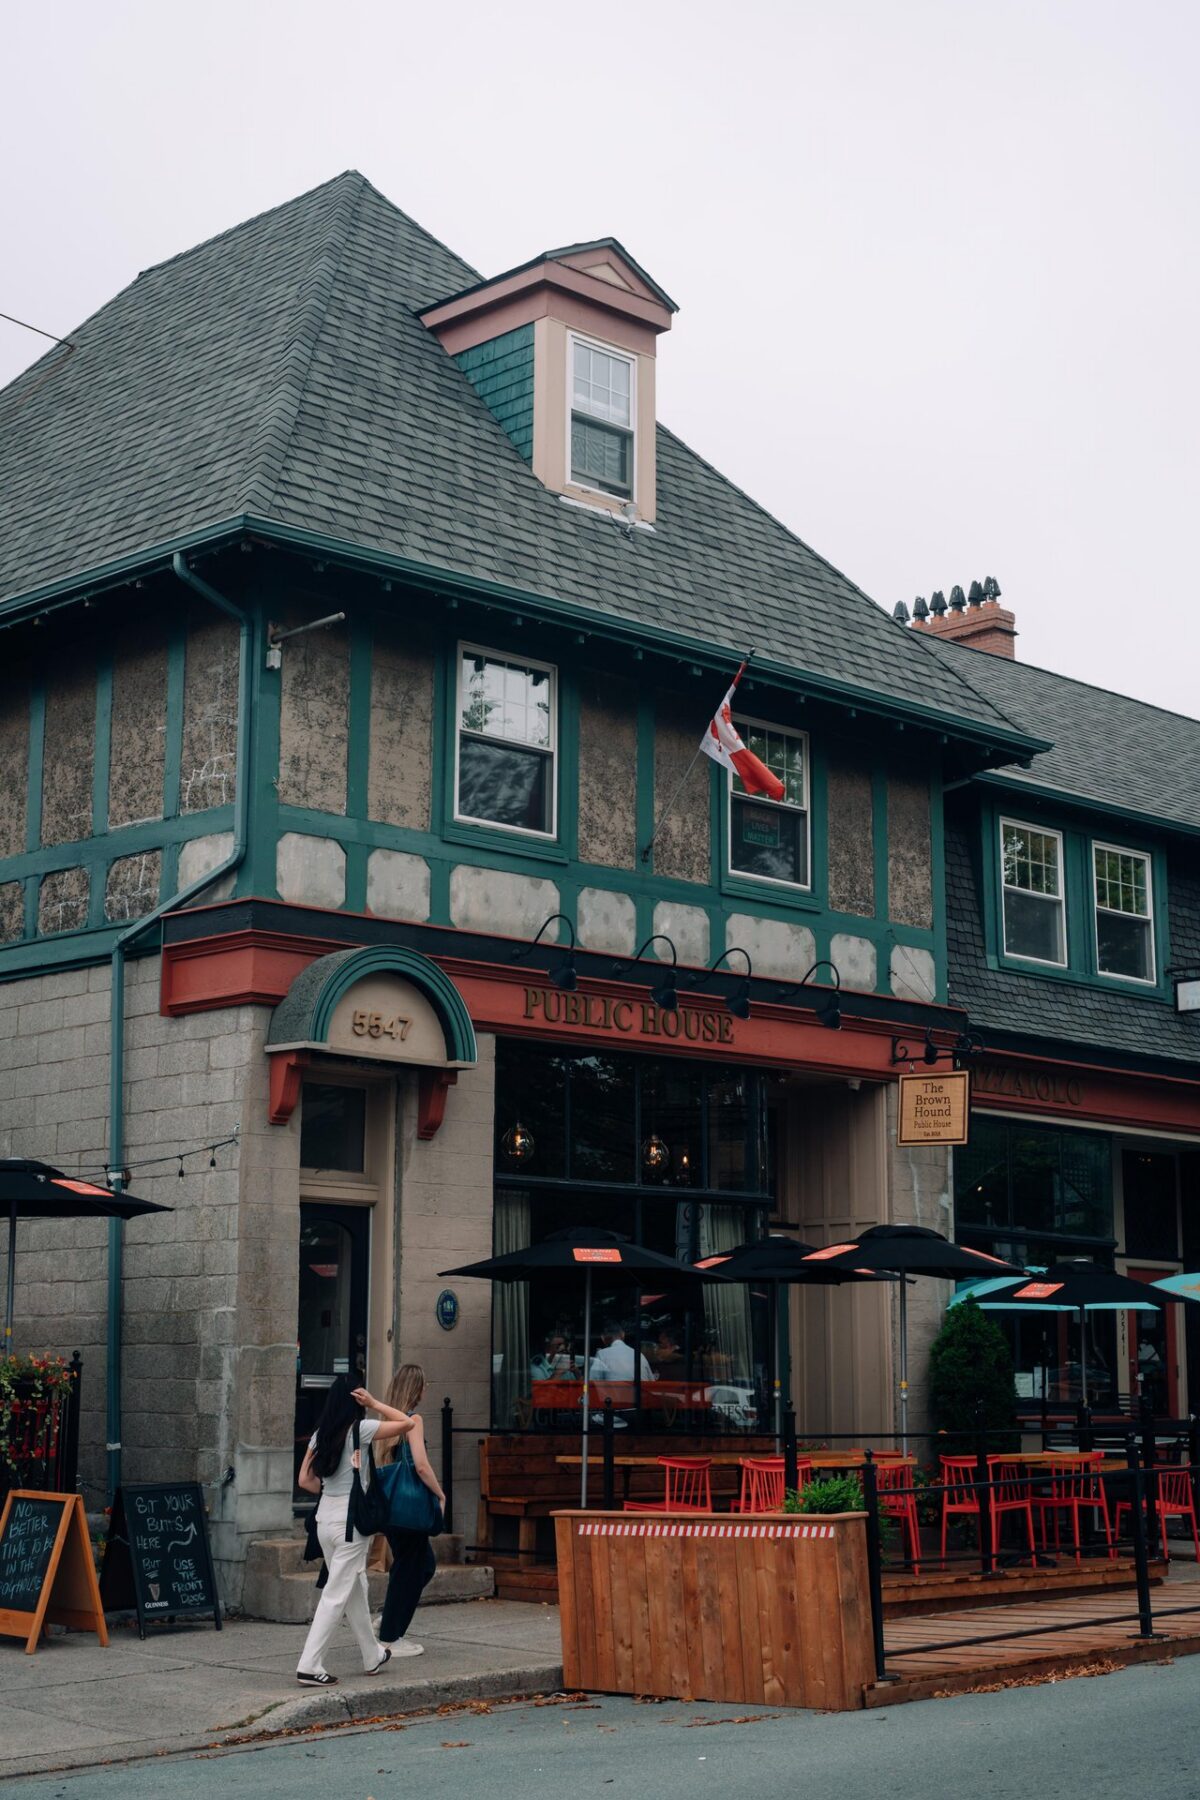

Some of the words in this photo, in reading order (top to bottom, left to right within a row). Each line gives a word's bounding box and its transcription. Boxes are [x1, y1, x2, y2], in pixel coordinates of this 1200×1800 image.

[522, 987, 633, 1032] PUBLIC
[639, 1003, 735, 1044] HOUSE
[352, 1009, 414, 1041] 5547
[922, 1081, 944, 1094] The
[915, 1094, 951, 1106] Brown
[914, 1105, 952, 1118] Hound
[913, 1120, 932, 1129] Public
[933, 1119, 952, 1128] House
[15, 1502, 33, 1518] NO
[136, 1496, 158, 1514] SIT
[164, 1494, 195, 1512] YOUR
[9, 1514, 49, 1539] BETTER
[146, 1515, 184, 1532] BUTTS
[3, 1539, 31, 1560] TIME
[32, 1537, 42, 1554] TO
[136, 1535, 161, 1550] HERE
[6, 1560, 17, 1576] IN
[20, 1556, 38, 1573] THE
[142, 1558, 161, 1570] BUT
[173, 1559, 195, 1571] USE
[178, 1570, 198, 1581] THE
[171, 1579, 204, 1593] FRONT
[144, 1601, 169, 1609] GUINNESS
